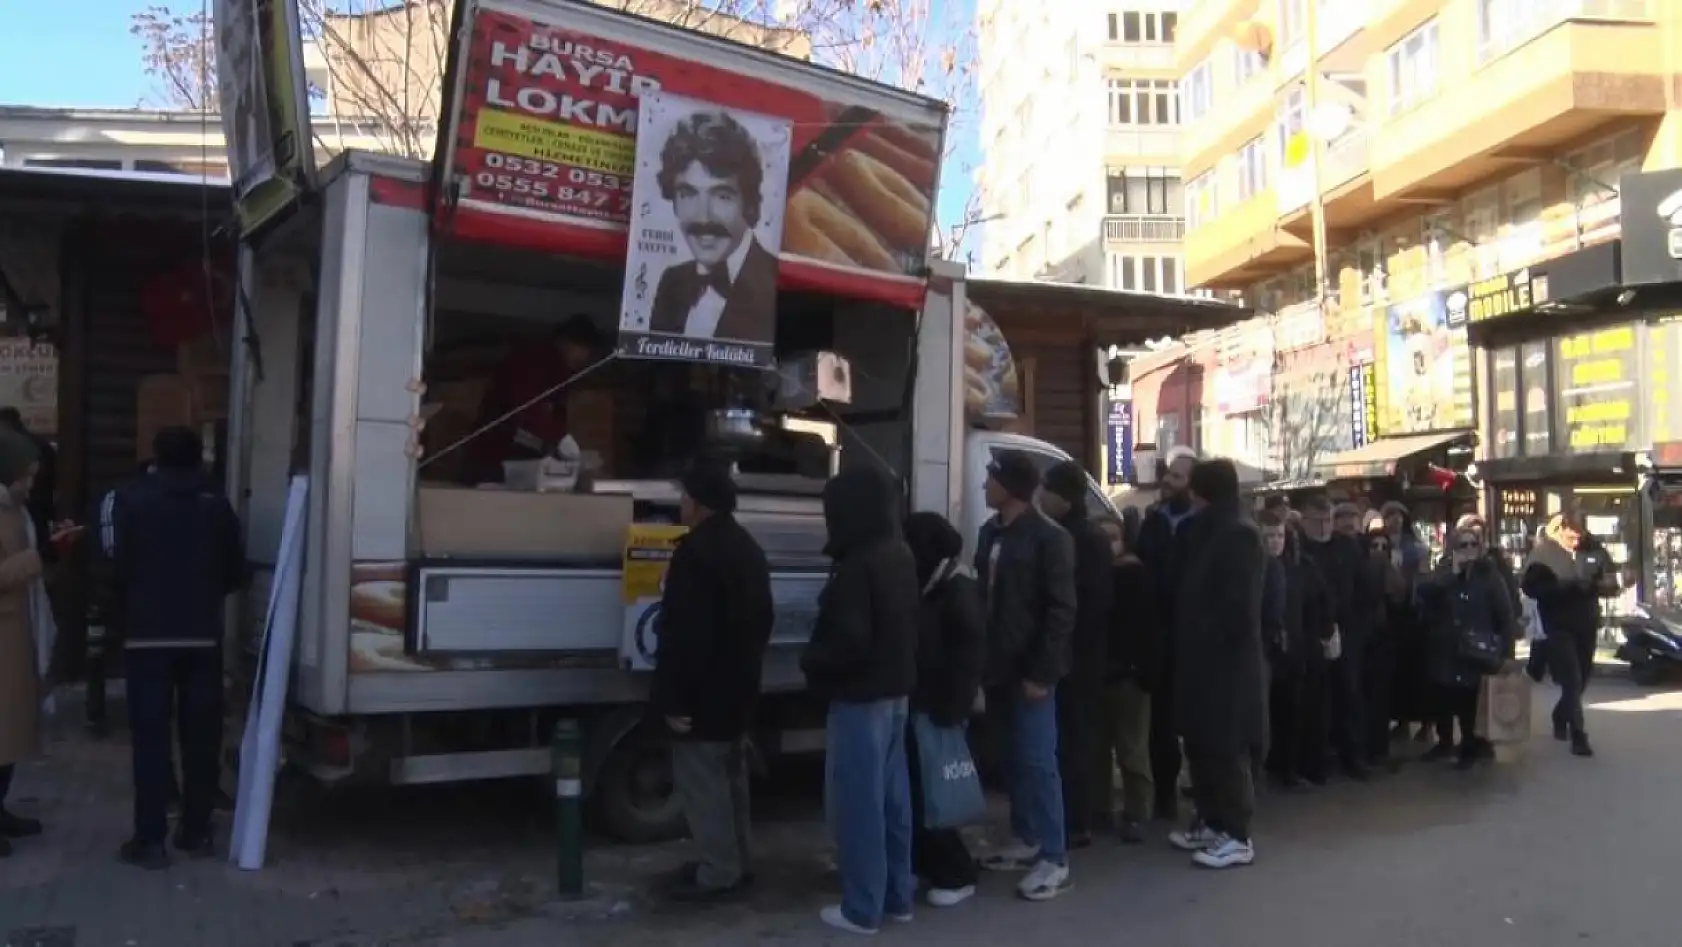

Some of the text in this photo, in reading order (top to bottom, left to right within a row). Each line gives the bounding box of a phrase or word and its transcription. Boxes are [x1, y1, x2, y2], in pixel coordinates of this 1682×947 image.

[529, 33, 634, 71] BURSA
[485, 153, 560, 178] 0532
[477, 172, 548, 197] 0555
[642, 229, 674, 242] FERDİ
[637, 336, 702, 358] Ferdiciler
